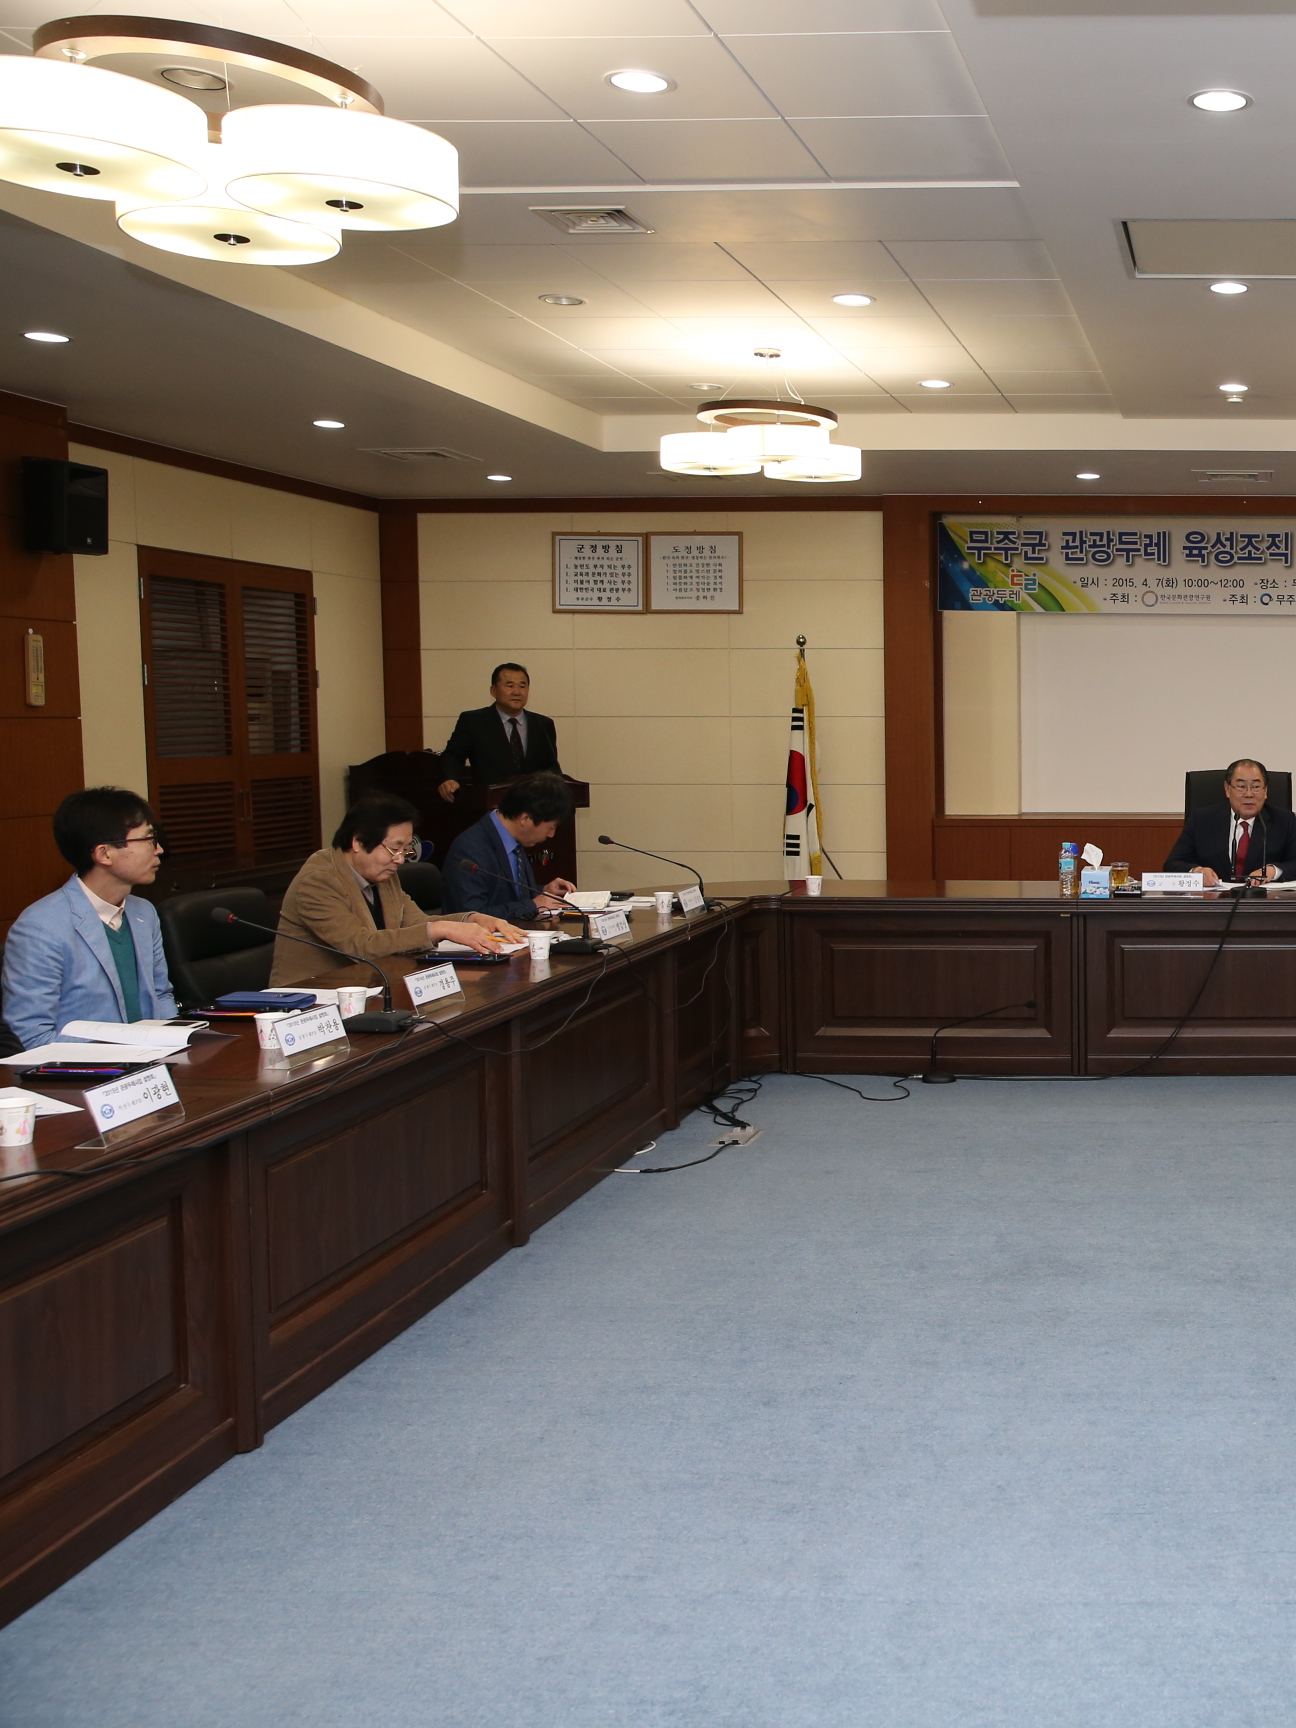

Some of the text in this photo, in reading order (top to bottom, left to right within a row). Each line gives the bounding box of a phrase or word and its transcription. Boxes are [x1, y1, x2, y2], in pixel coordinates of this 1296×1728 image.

[966, 530, 1048, 563] 무주군
[1060, 530, 1170, 565] 관광두레
[1182, 530, 1291, 566] 육성조직
[1080, 577, 1099, 588] 일시
[1112, 578, 1137, 589] 2015.
[1156, 578, 1178, 589] 7(화)
[1183, 578, 1244, 589] 10:00~12:00
[1259, 578, 1279, 590] 장소
[970, 588, 1021, 603] 관광두레
[1110, 593, 1130, 604] 주최
[1229, 594, 1249, 605] 주최
[317, 1018, 340, 1035] 박찬용
[143, 1081, 171, 1102] 이광현
